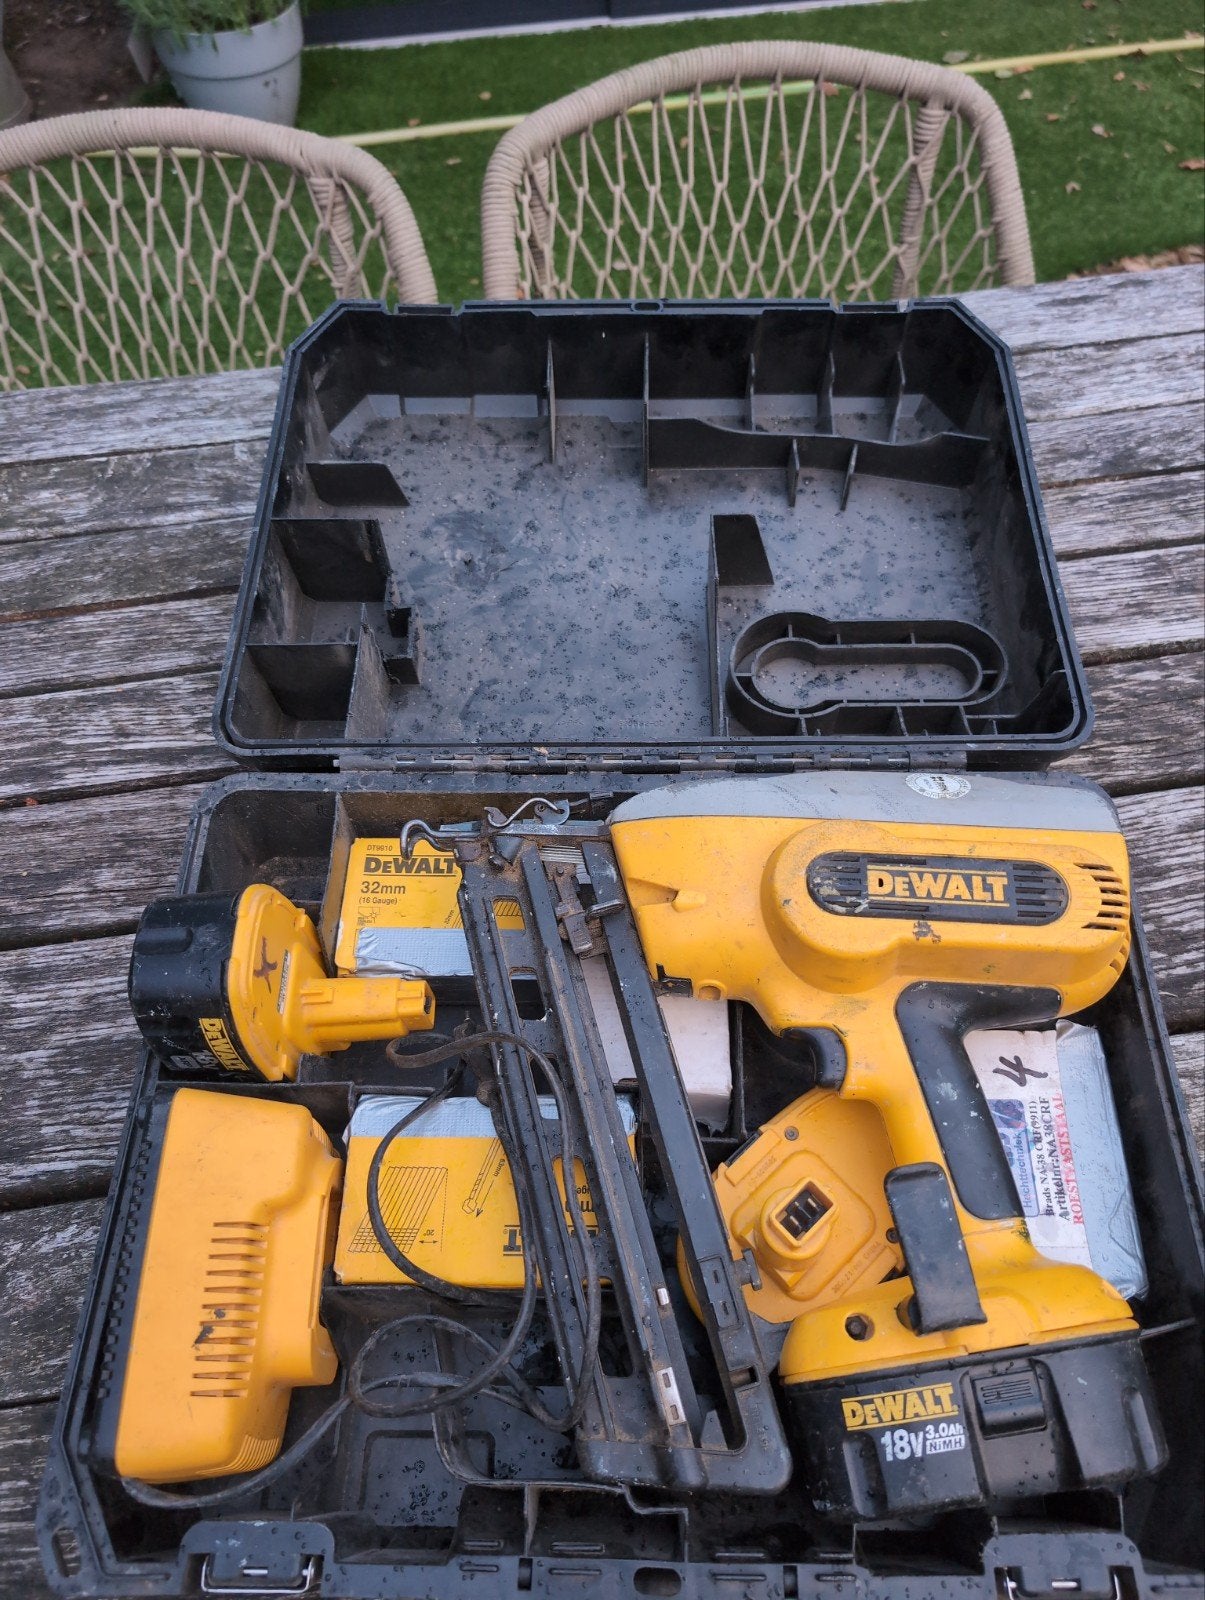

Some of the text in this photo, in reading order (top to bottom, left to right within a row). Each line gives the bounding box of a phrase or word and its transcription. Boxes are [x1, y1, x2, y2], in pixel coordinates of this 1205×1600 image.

[360, 880, 406, 895] 32mm
[358, 897, 398, 905] (16 Gauge)
[1042, 1187, 1054, 1217] Brads
[880, 1423, 964, 1462] 18V 3.0Ah
